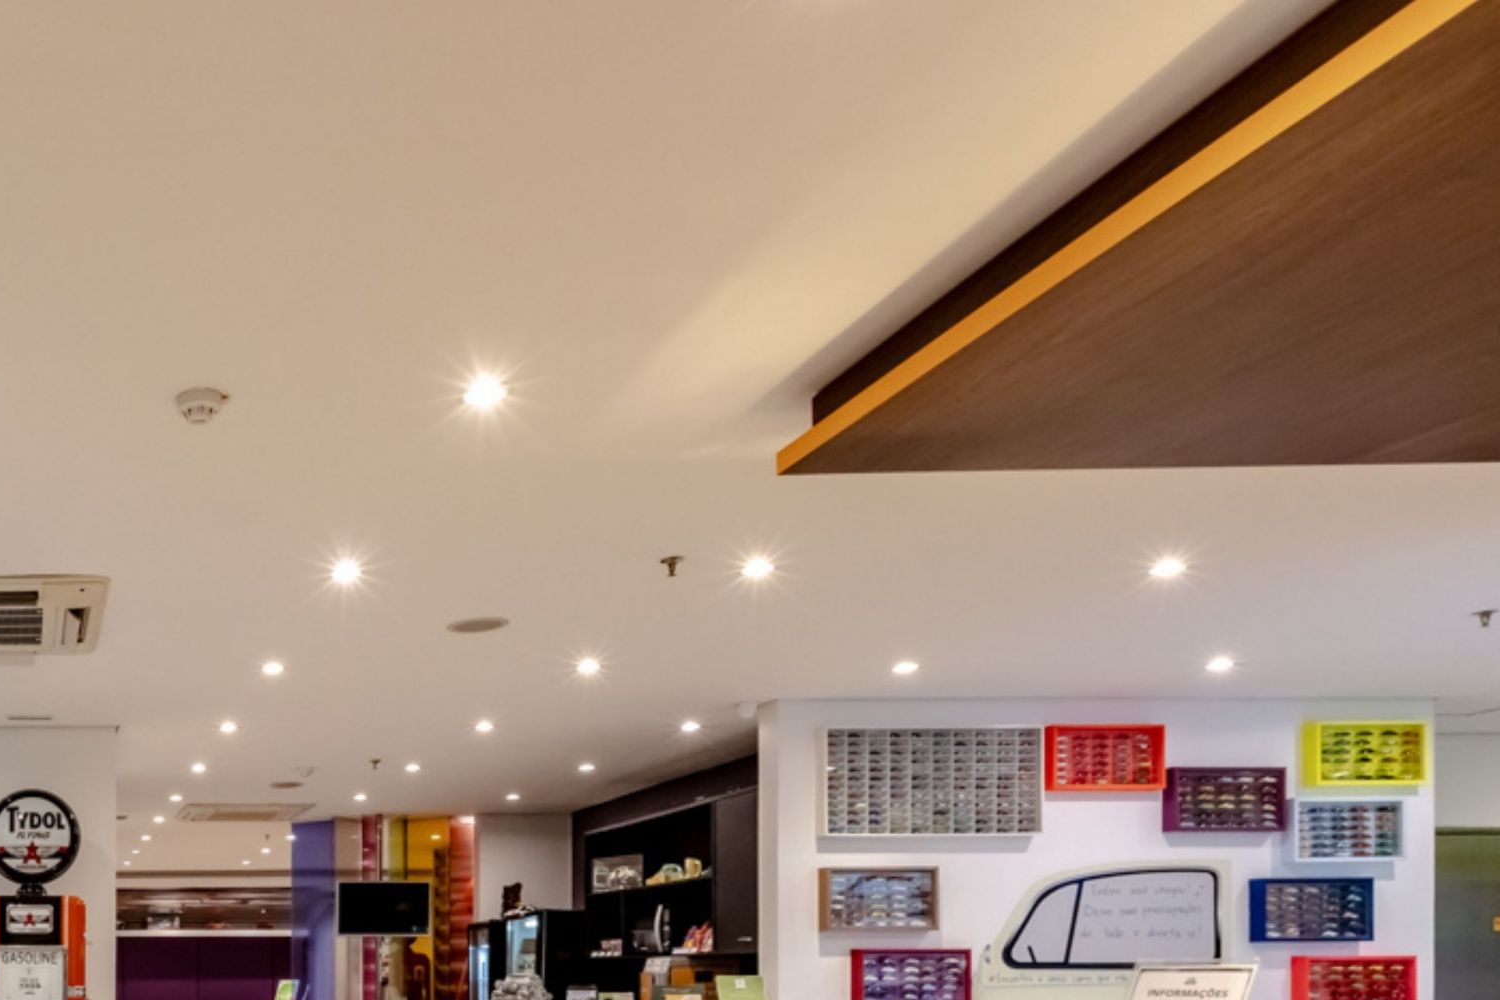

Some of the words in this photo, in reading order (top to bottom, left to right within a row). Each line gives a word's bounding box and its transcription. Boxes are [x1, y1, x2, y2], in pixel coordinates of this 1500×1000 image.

[6, 805, 66, 833] TYDOL
[1, 951, 58, 965] GASOLINE
[1147, 987, 1229, 999] INFORMAÇÕES
